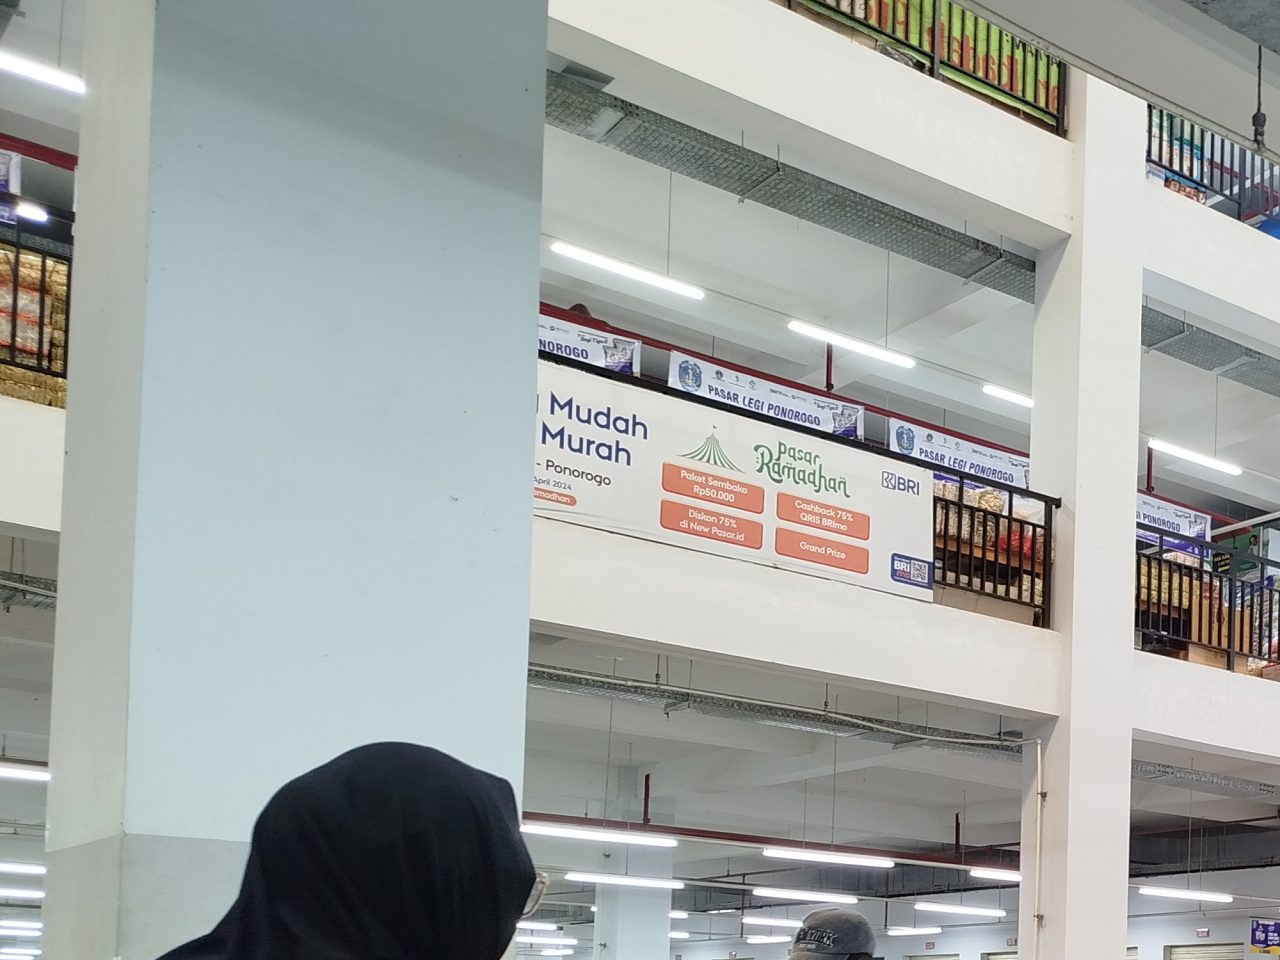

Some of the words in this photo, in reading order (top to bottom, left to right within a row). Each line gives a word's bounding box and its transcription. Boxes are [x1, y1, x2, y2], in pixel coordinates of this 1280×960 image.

[550, 390, 647, 440] Mudah
[708, 383, 739, 404] PASAR
[743, 396, 764, 412] LEGI
[767, 403, 821, 427] PONOROGO
[541, 420, 631, 466] Murah
[545, 459, 611, 487] Ponorogo
[753, 444, 852, 498] Ramadhan
[919, 447, 945, 465] PASAR
[948, 456, 966, 471] LEGI
[969, 462, 1014, 483] PONOROGO
[552, 480, 572, 490] 2024
[680, 469, 706, 485] Paket
[707, 477, 748, 495] Sembako
[897, 476, 920, 496] BRI
[693, 485, 735, 503] Rp50.000
[688, 510, 717, 525] Diskon
[719, 516, 737, 528] 75%
[795, 500, 836, 517] Cashback
[836, 510, 854, 522] 75%
[800, 512, 820, 525] QRIS
[821, 517, 848, 531] BRImo
[679, 519, 689, 528] di
[690, 522, 710, 533] New
[711, 527, 744, 542] Pasar.id
[1142, 513, 1180, 533] PONOROGO
[800, 541, 825, 555] Grand
[826, 546, 846, 560] Prize
[894, 560, 910, 572] BRI
